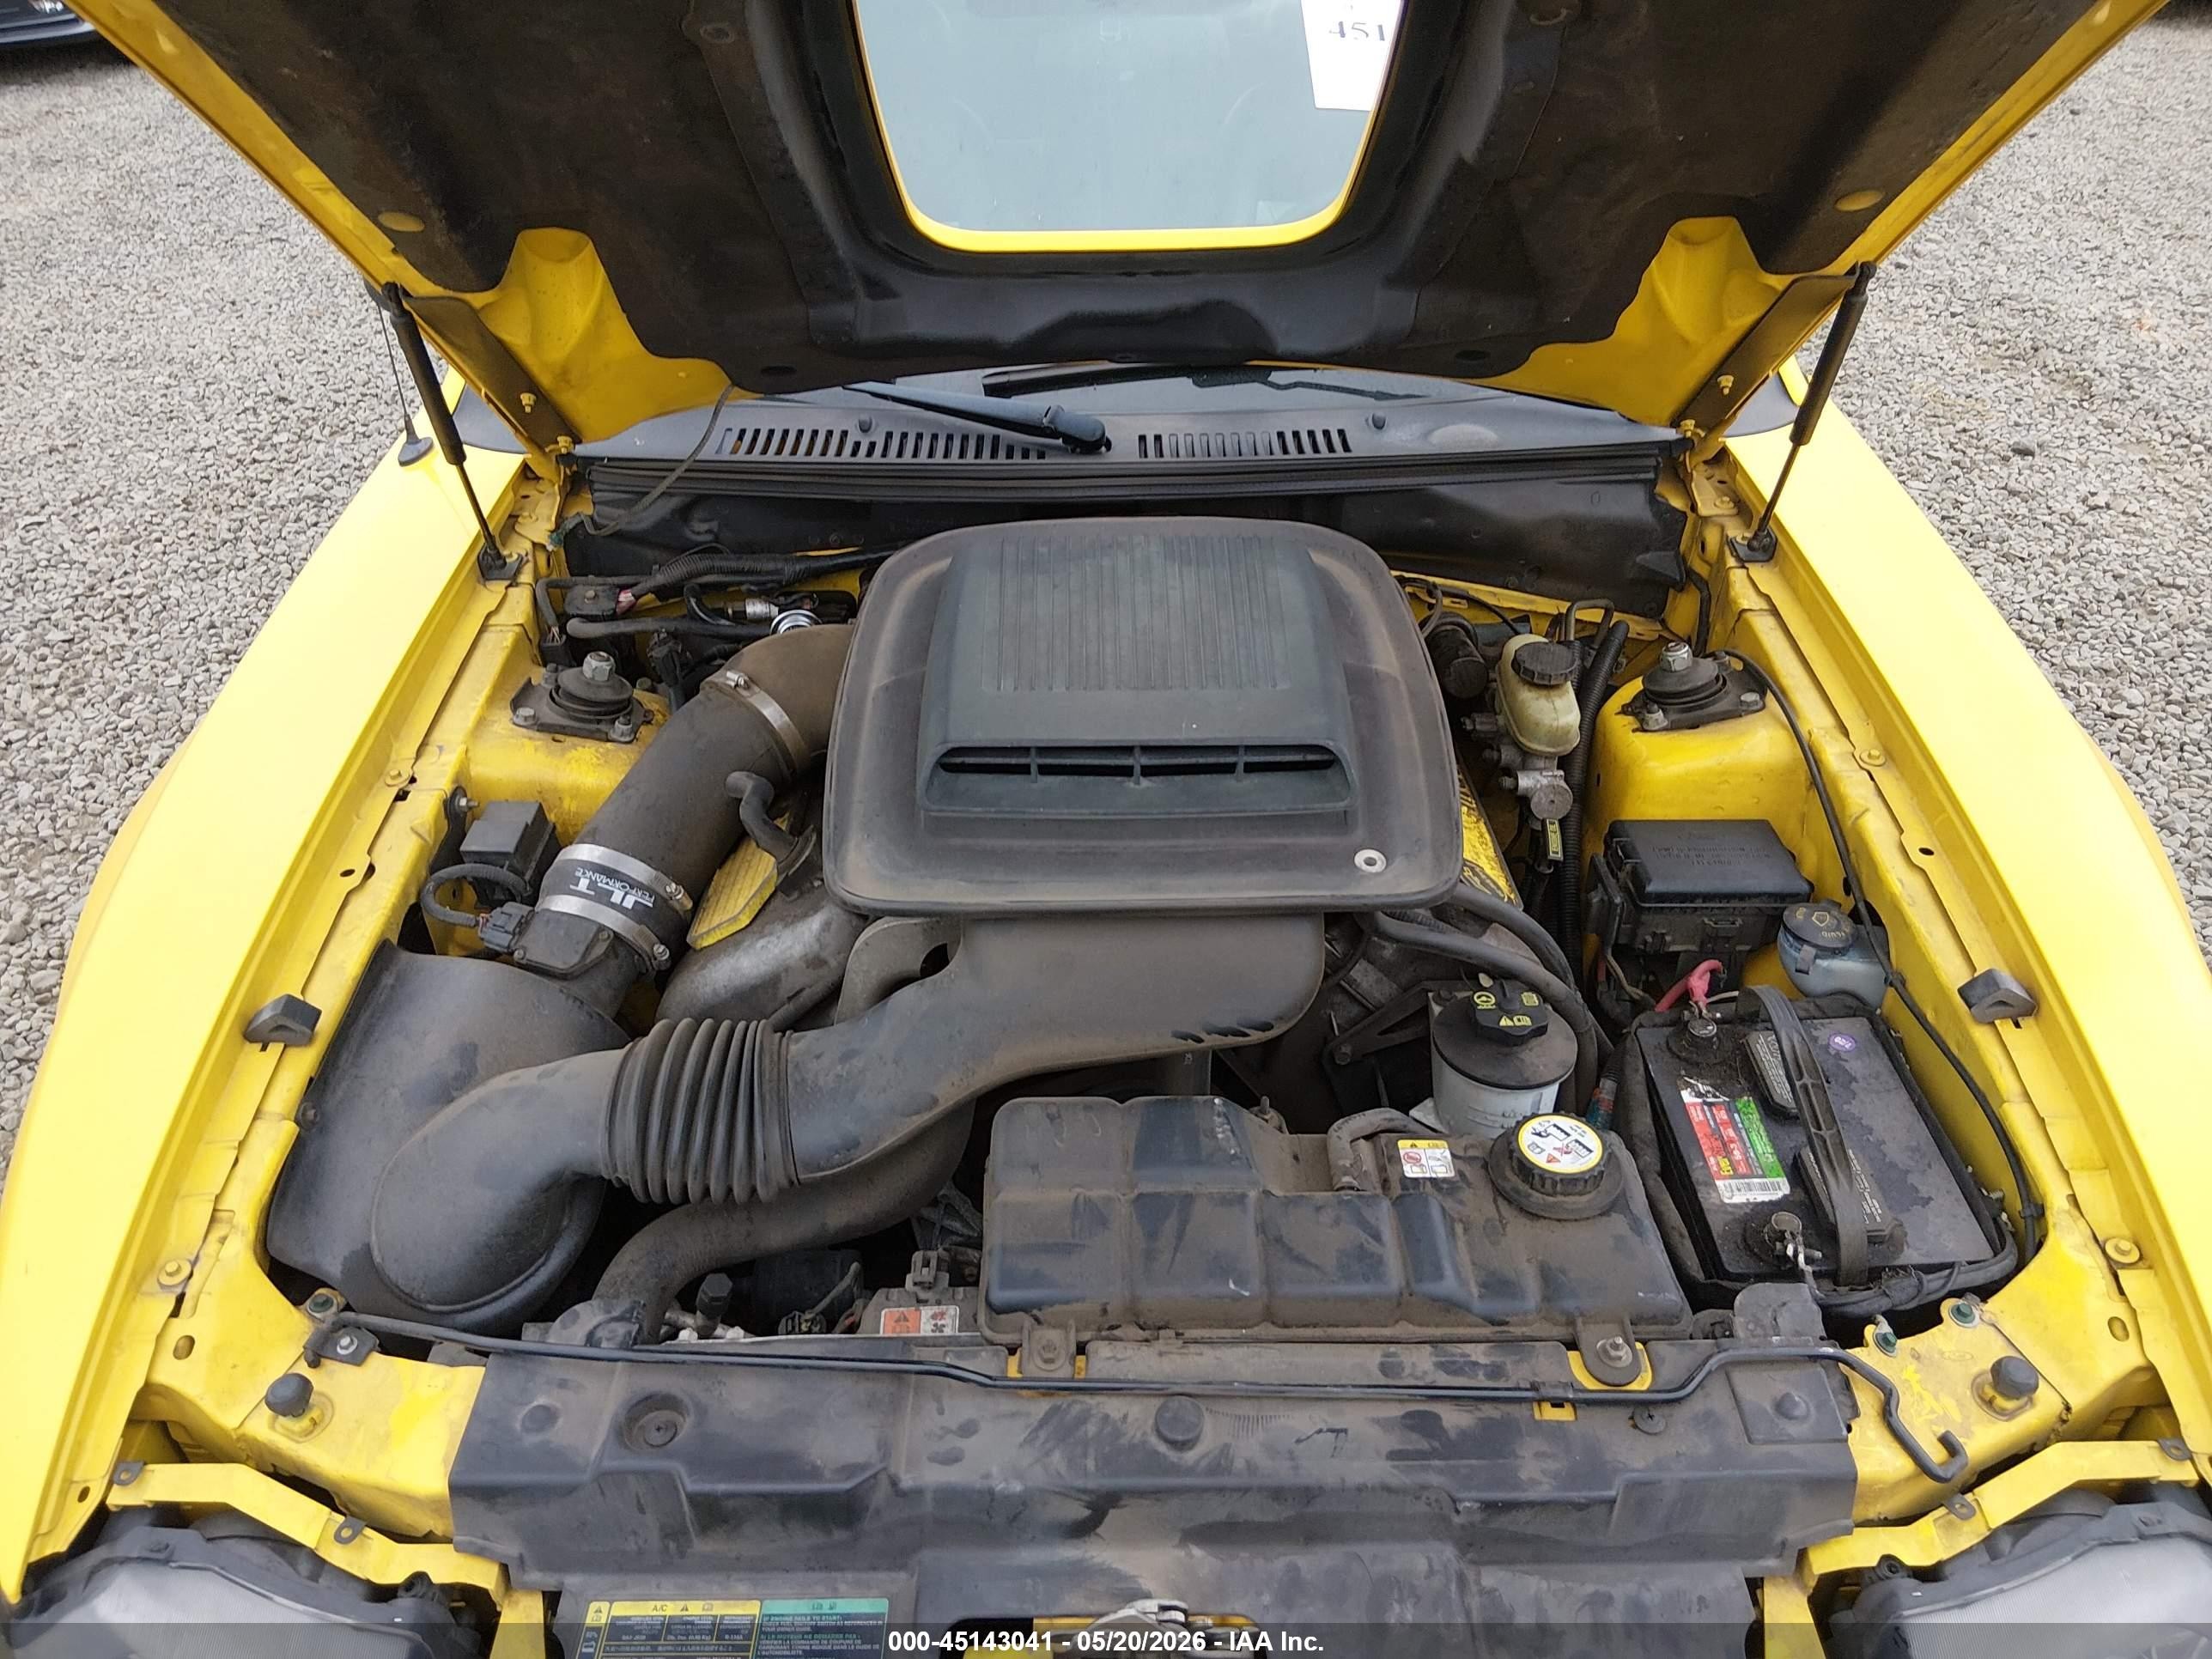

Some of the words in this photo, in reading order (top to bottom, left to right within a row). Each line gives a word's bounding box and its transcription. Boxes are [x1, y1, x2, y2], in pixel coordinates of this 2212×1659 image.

[569, 877, 653, 910] JLT
[574, 867, 656, 903] PERFORMANCE
[652, 1604, 668, 1613] A/C
